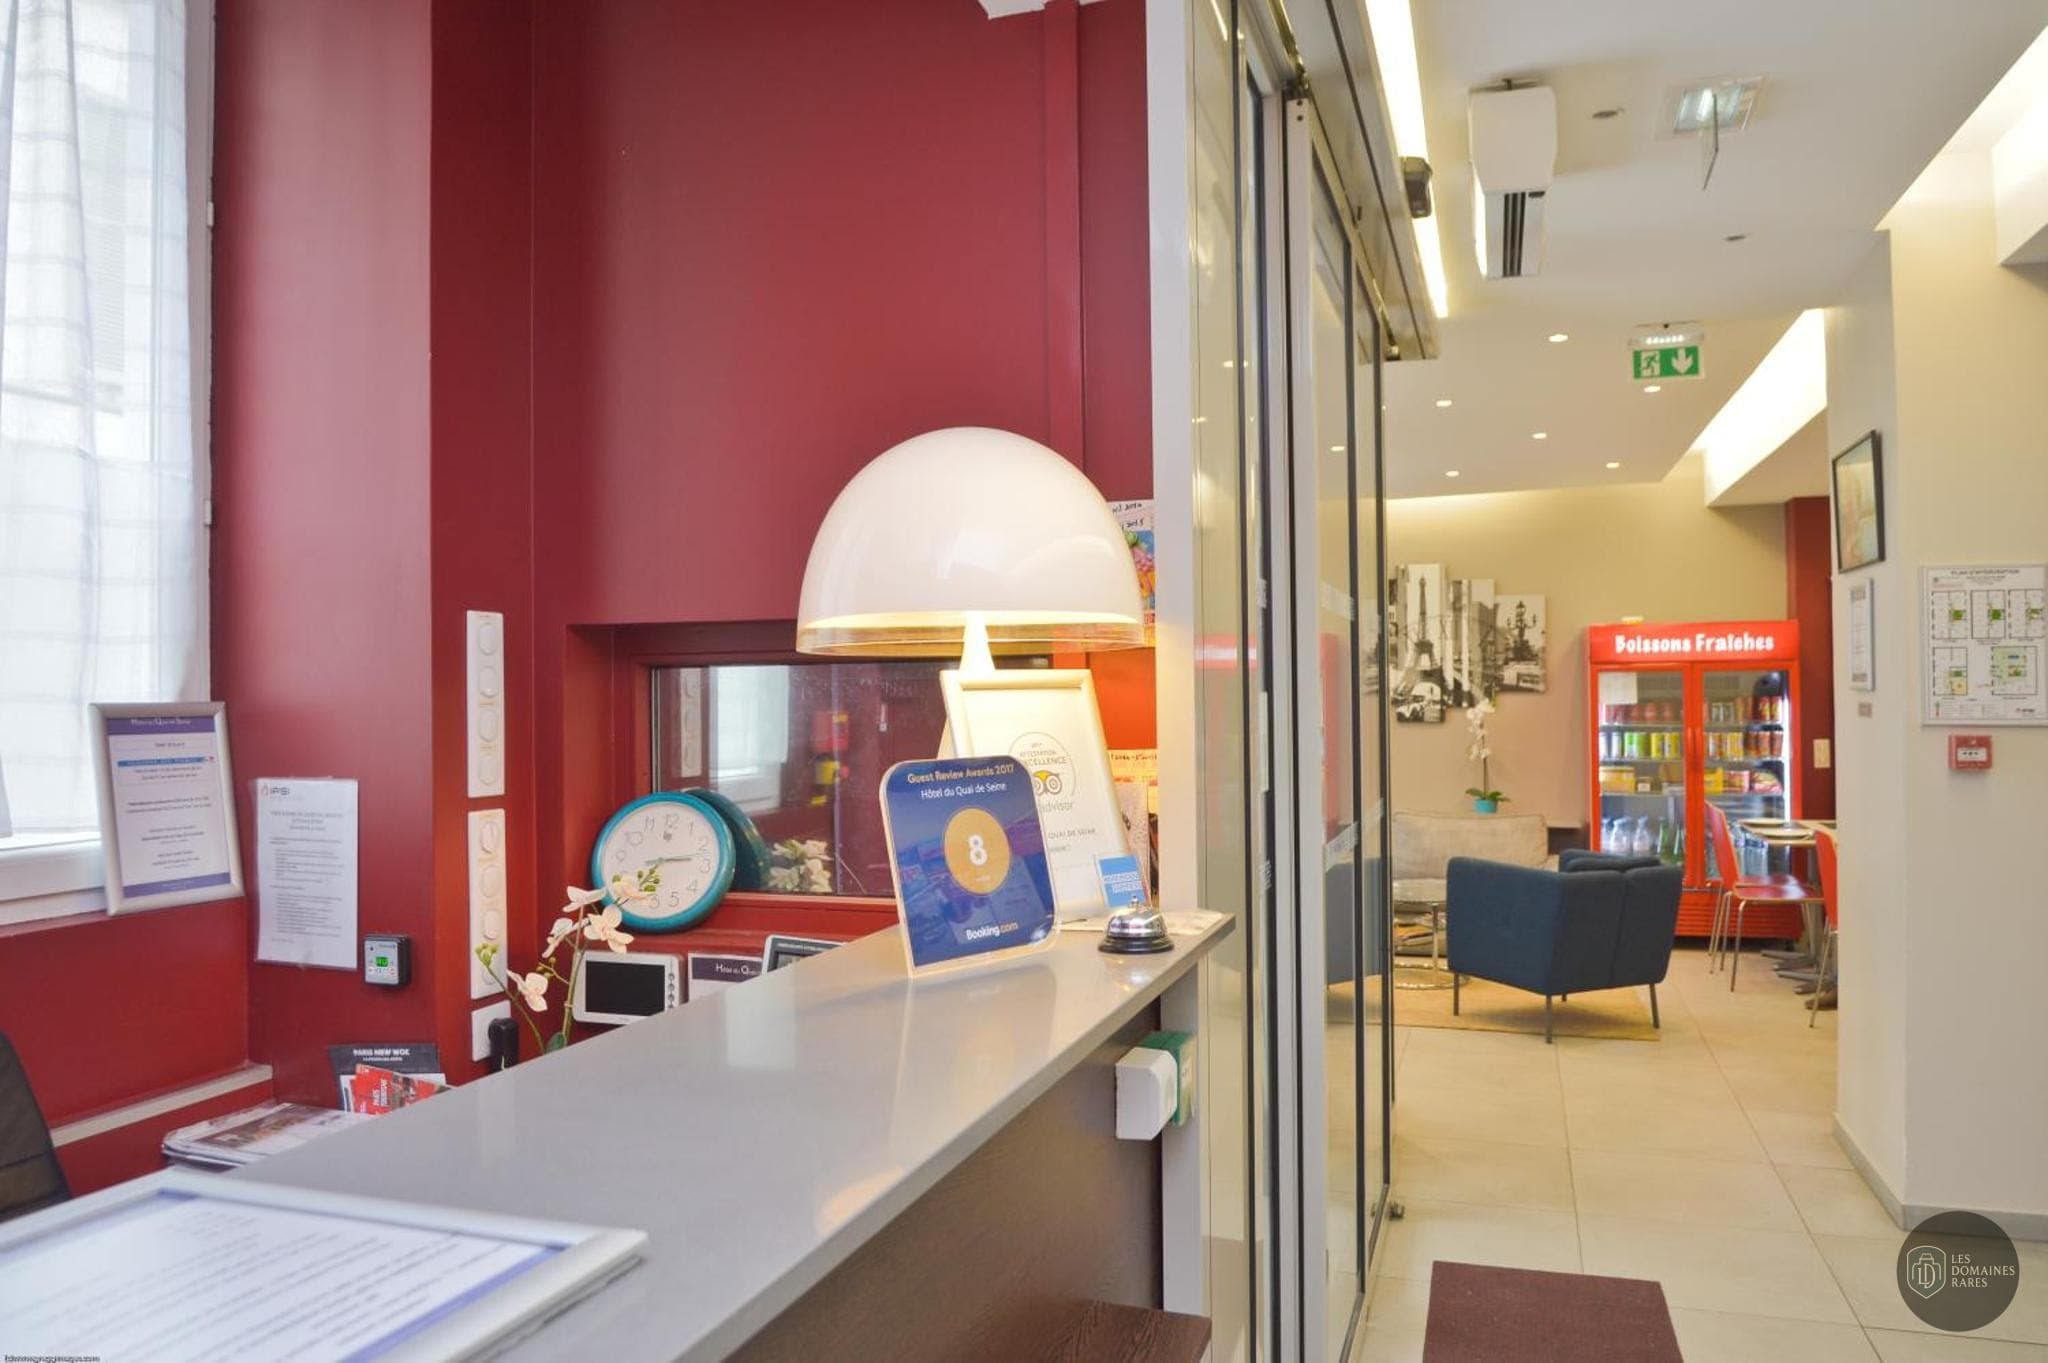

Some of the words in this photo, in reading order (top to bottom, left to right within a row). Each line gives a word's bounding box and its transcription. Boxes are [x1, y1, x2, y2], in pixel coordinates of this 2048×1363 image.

[1614, 634, 1691, 654] Boissons
[907, 772, 934, 784] Guest
[935, 769, 963, 781] Review
[966, 766, 994, 778] Awards
[995, 764, 1014, 775] 2017
[921, 786, 943, 799] Hôtel
[944, 787, 955, 797] du
[956, 784, 974, 797] Quai
[975, 783, 986, 793] de
[986, 781, 1007, 792] Seine
[968, 834, 989, 867] 8
[686, 879, 700, 895] 4
[668, 891, 681, 908] 5
[966, 920, 1019, 941] Booking.com
[353, 1048, 373, 1057] PARIS
[374, 1048, 392, 1056] NEW
